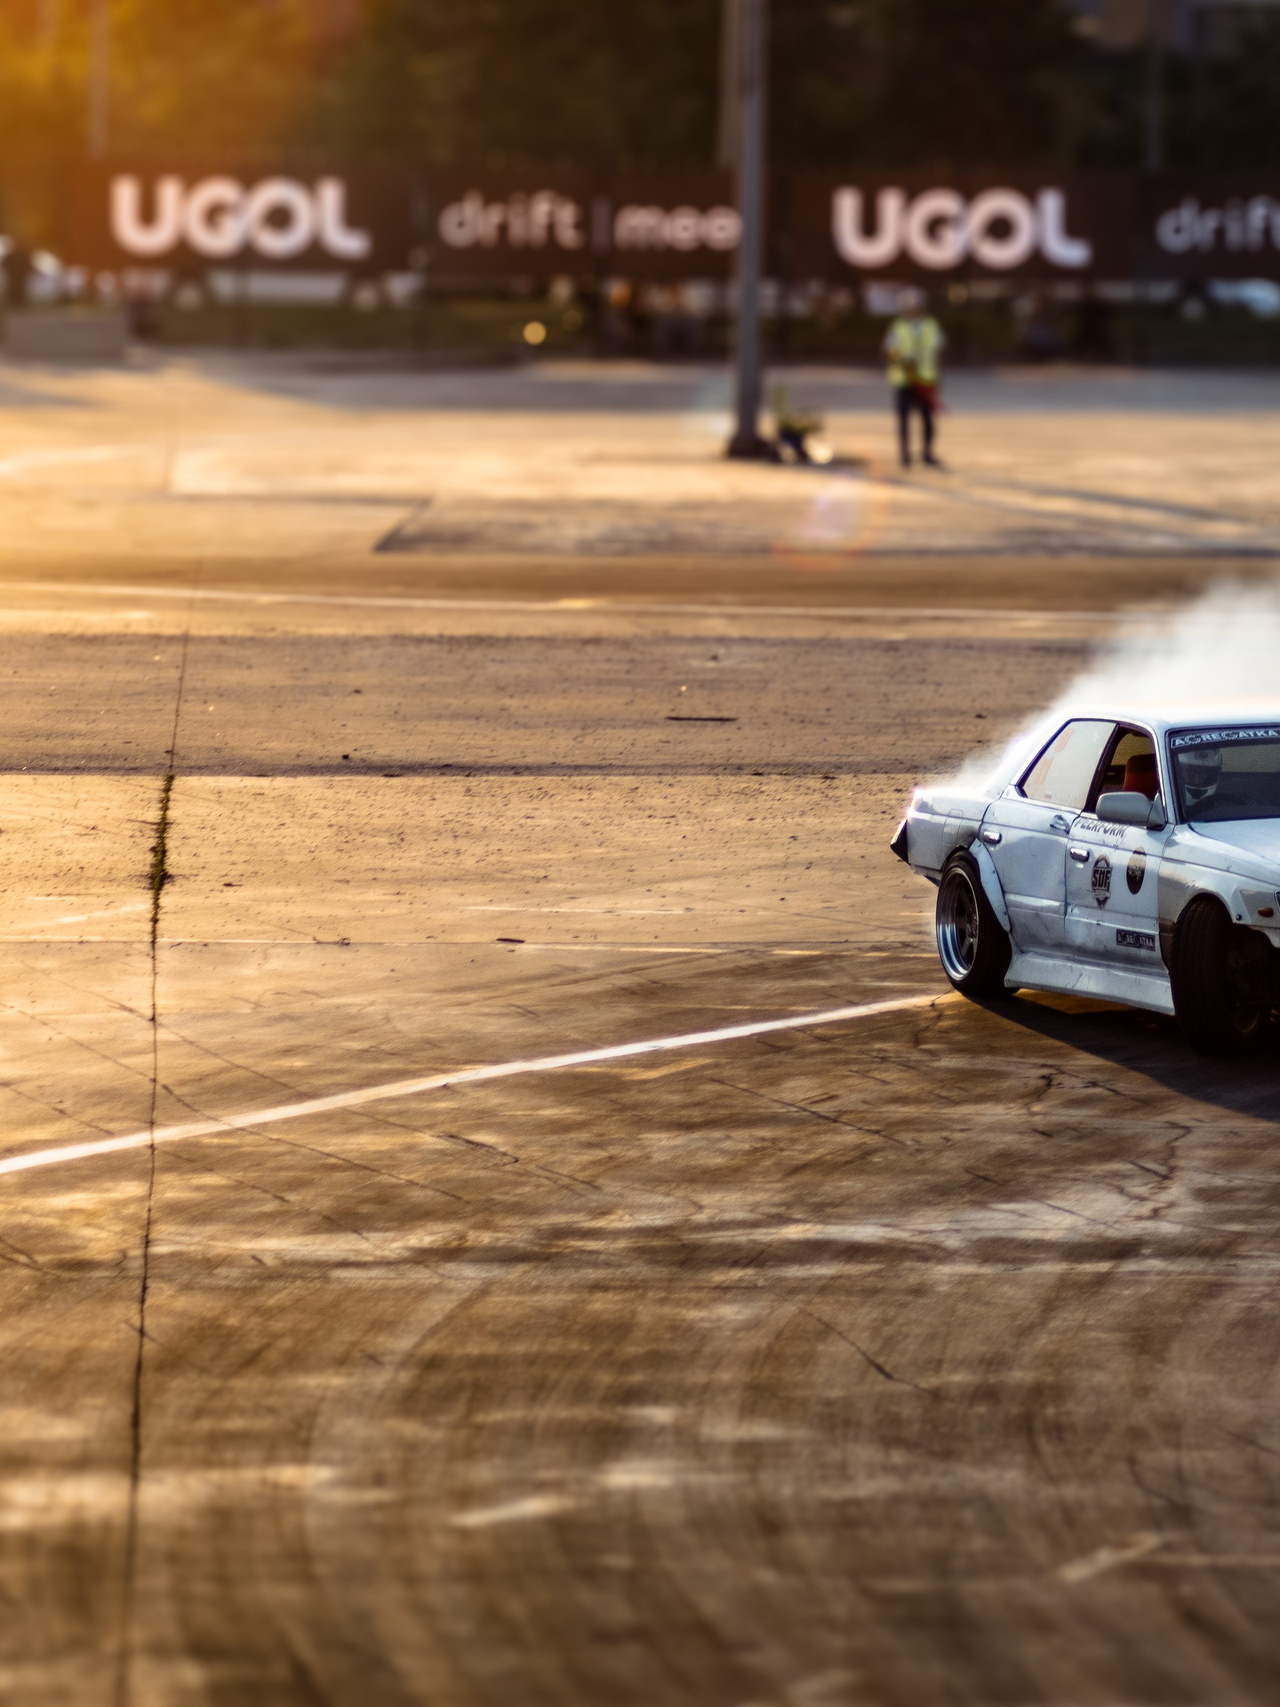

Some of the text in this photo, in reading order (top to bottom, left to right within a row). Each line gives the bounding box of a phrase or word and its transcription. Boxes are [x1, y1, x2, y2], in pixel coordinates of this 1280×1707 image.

[110, 174, 370, 260] UGOL
[439, 190, 741, 250] drift mee
[832, 186, 1092, 270] UGOL
[1174, 729, 1279, 746] AGREGATKA
